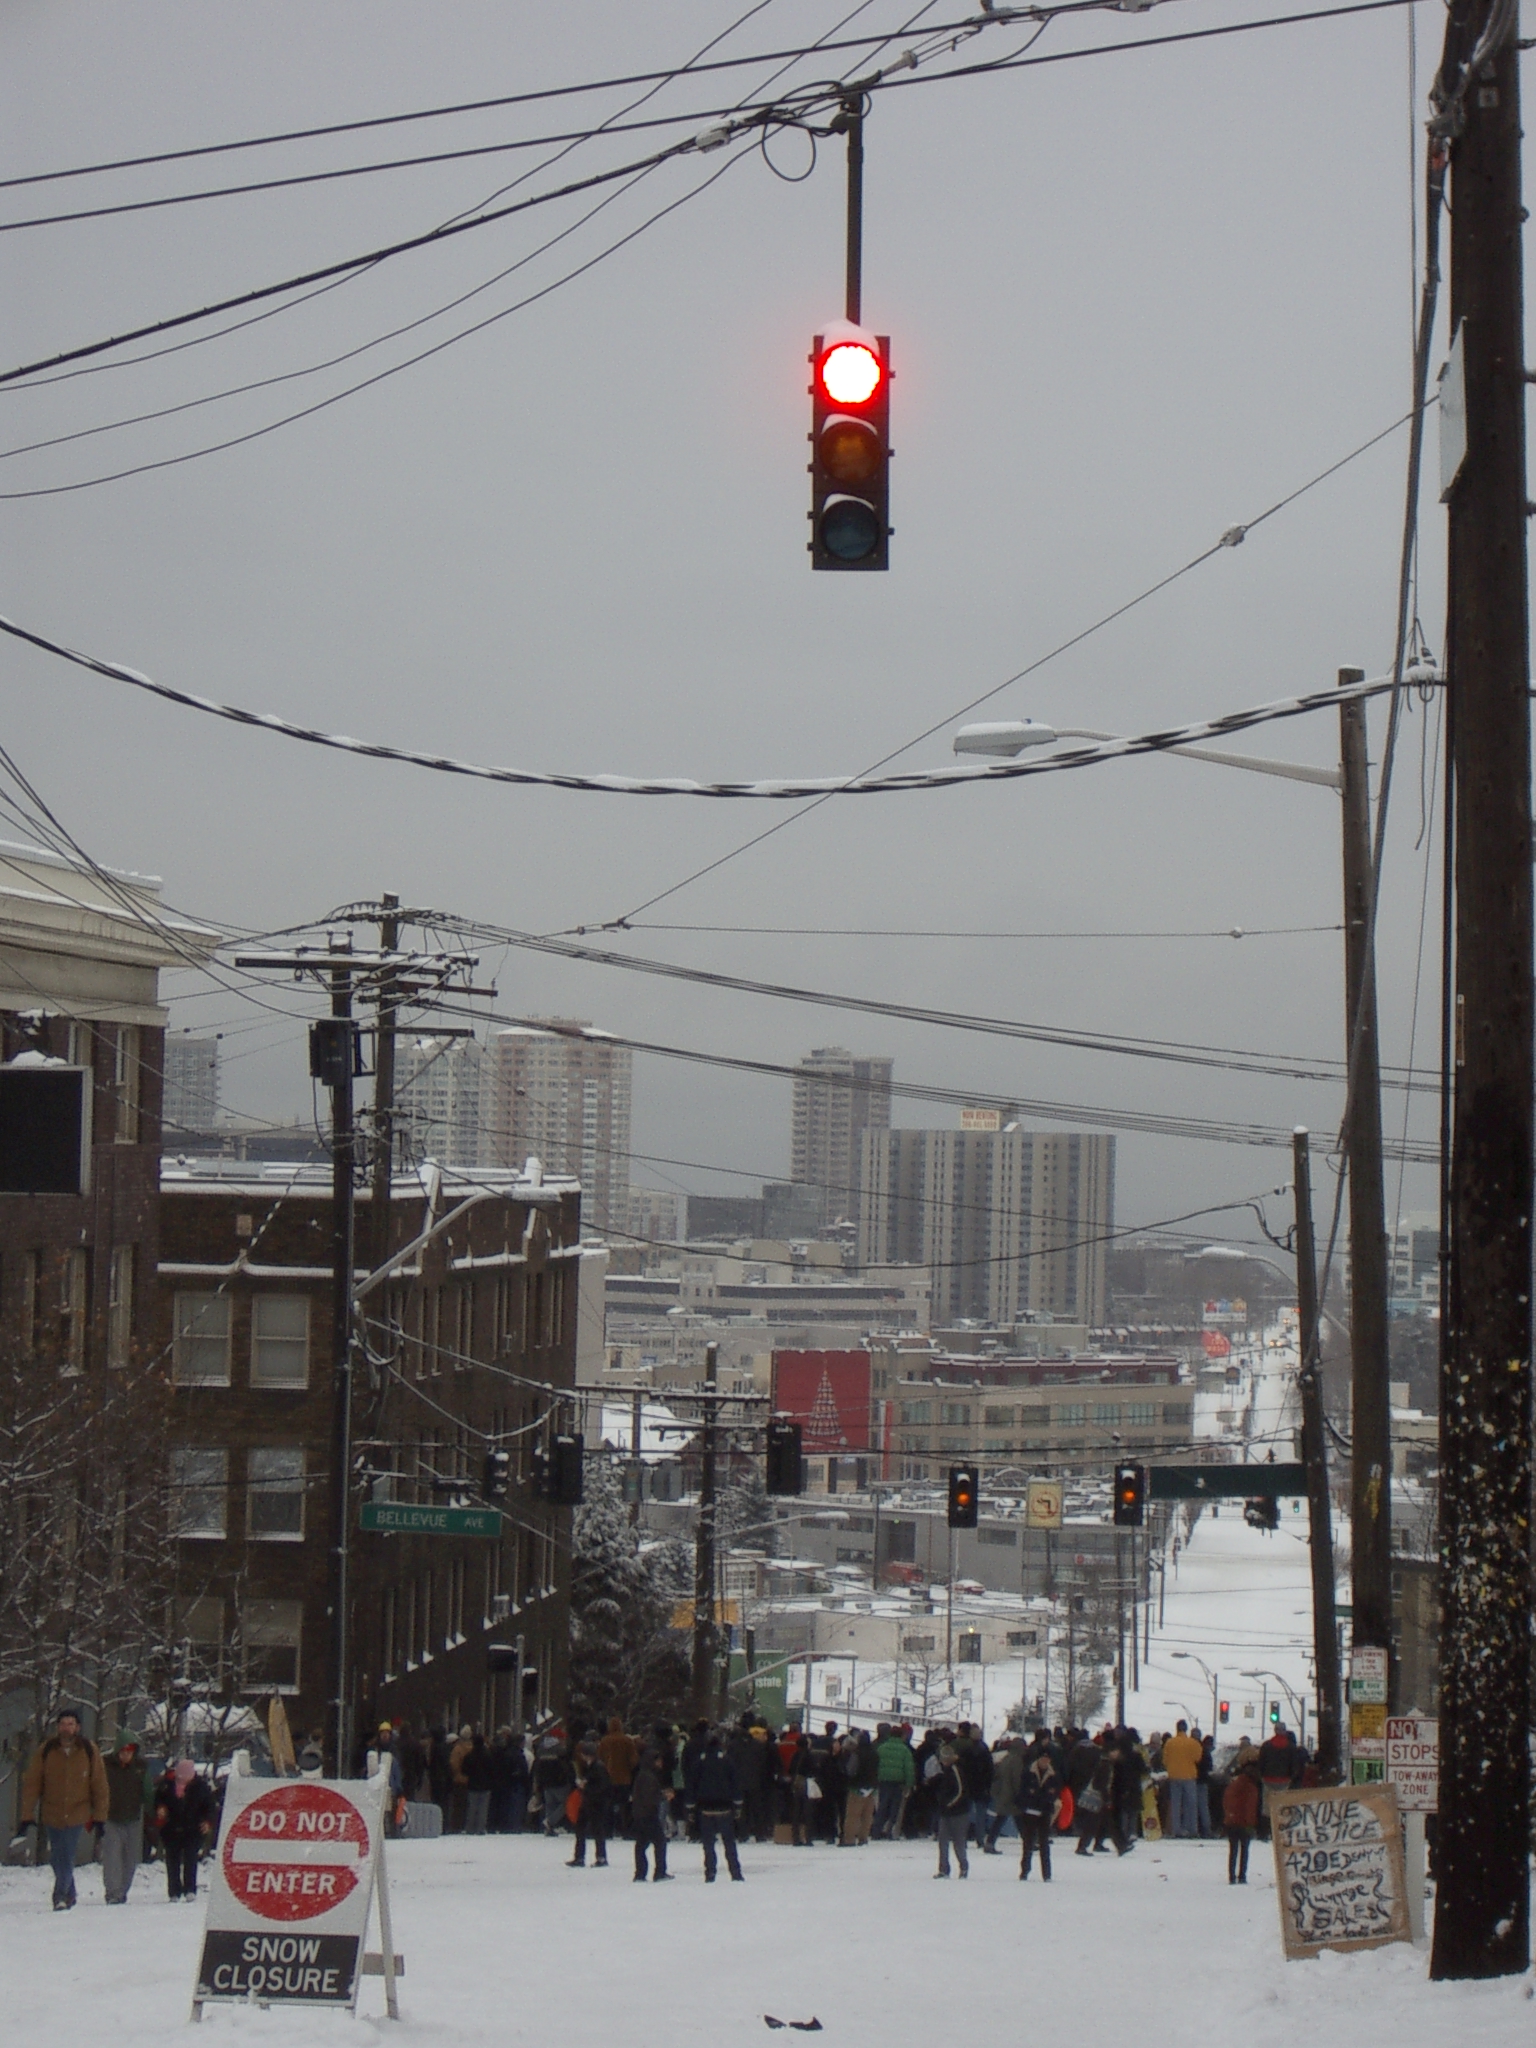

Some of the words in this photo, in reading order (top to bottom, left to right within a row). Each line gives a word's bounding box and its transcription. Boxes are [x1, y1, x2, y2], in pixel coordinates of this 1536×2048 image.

[376, 1510, 447, 1527] BELLEVUE
[464, 1517, 484, 1528] AVE
[1390, 1721, 1414, 1738] NO
[1402, 1784, 1429, 1795] ZONE
[249, 1810, 287, 1833] DO
[296, 1811, 351, 1833] NOT
[1284, 1819, 1379, 1847] JUSTICE
[1329, 1850, 1341, 1868] E
[246, 1871, 337, 1895] ENTER
[241, 1936, 321, 1964] SNOW
[213, 1964, 340, 1994] CLOSURE
